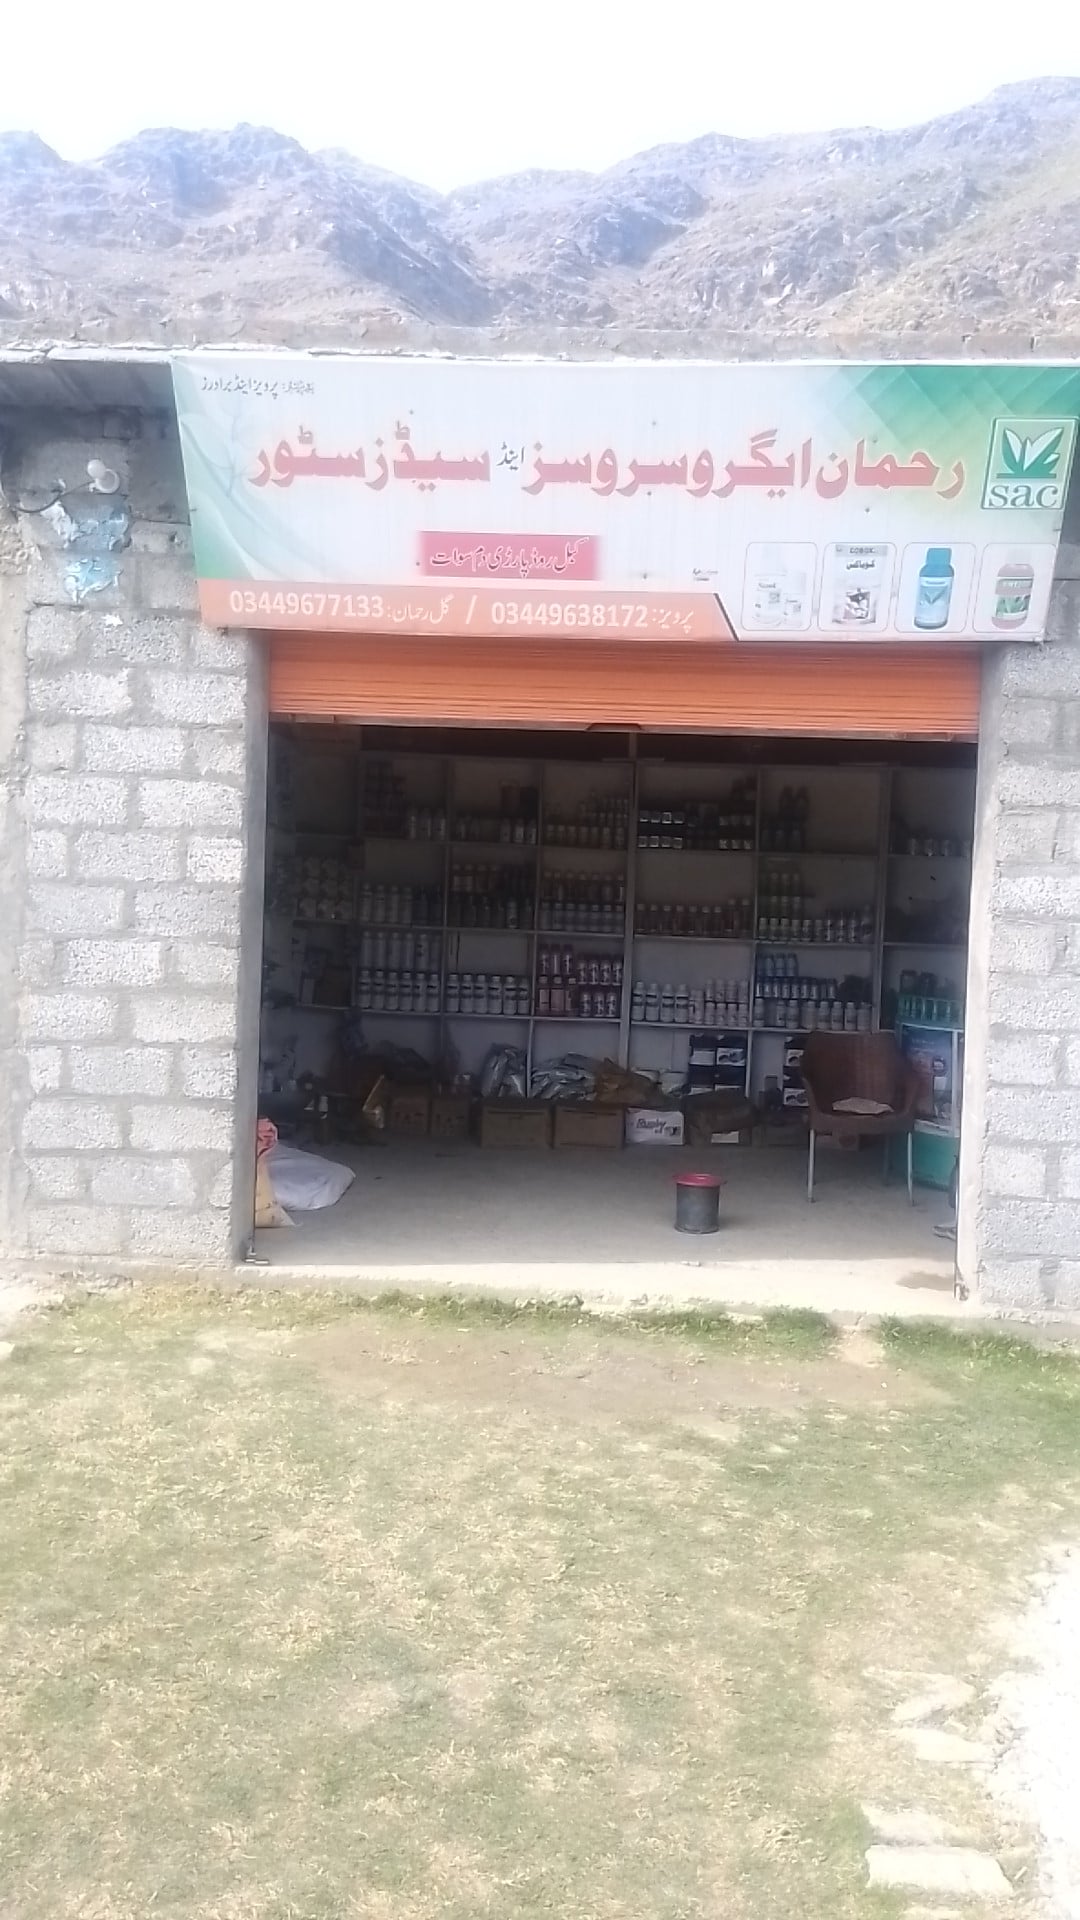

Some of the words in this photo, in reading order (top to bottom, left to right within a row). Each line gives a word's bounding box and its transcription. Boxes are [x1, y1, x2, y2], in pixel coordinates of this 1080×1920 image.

[247, 424, 367, 488] سٹور
[364, 420, 491, 492] سیڈز
[496, 440, 525, 471] اینڈ
[520, 441, 689, 498] سروسز
[687, 428, 813, 499] ایگرو
[814, 437, 966, 500] رحمان
[988, 484, 1058, 508] sac
[429, 547, 474, 567] سوات
[529, 546, 559, 570] روڈ
[552, 536, 590, 573] کبل
[229, 589, 385, 619] 03449677133
[428, 593, 456, 624] گل
[465, 594, 478, 625] /
[491, 601, 649, 628] 03449638172
